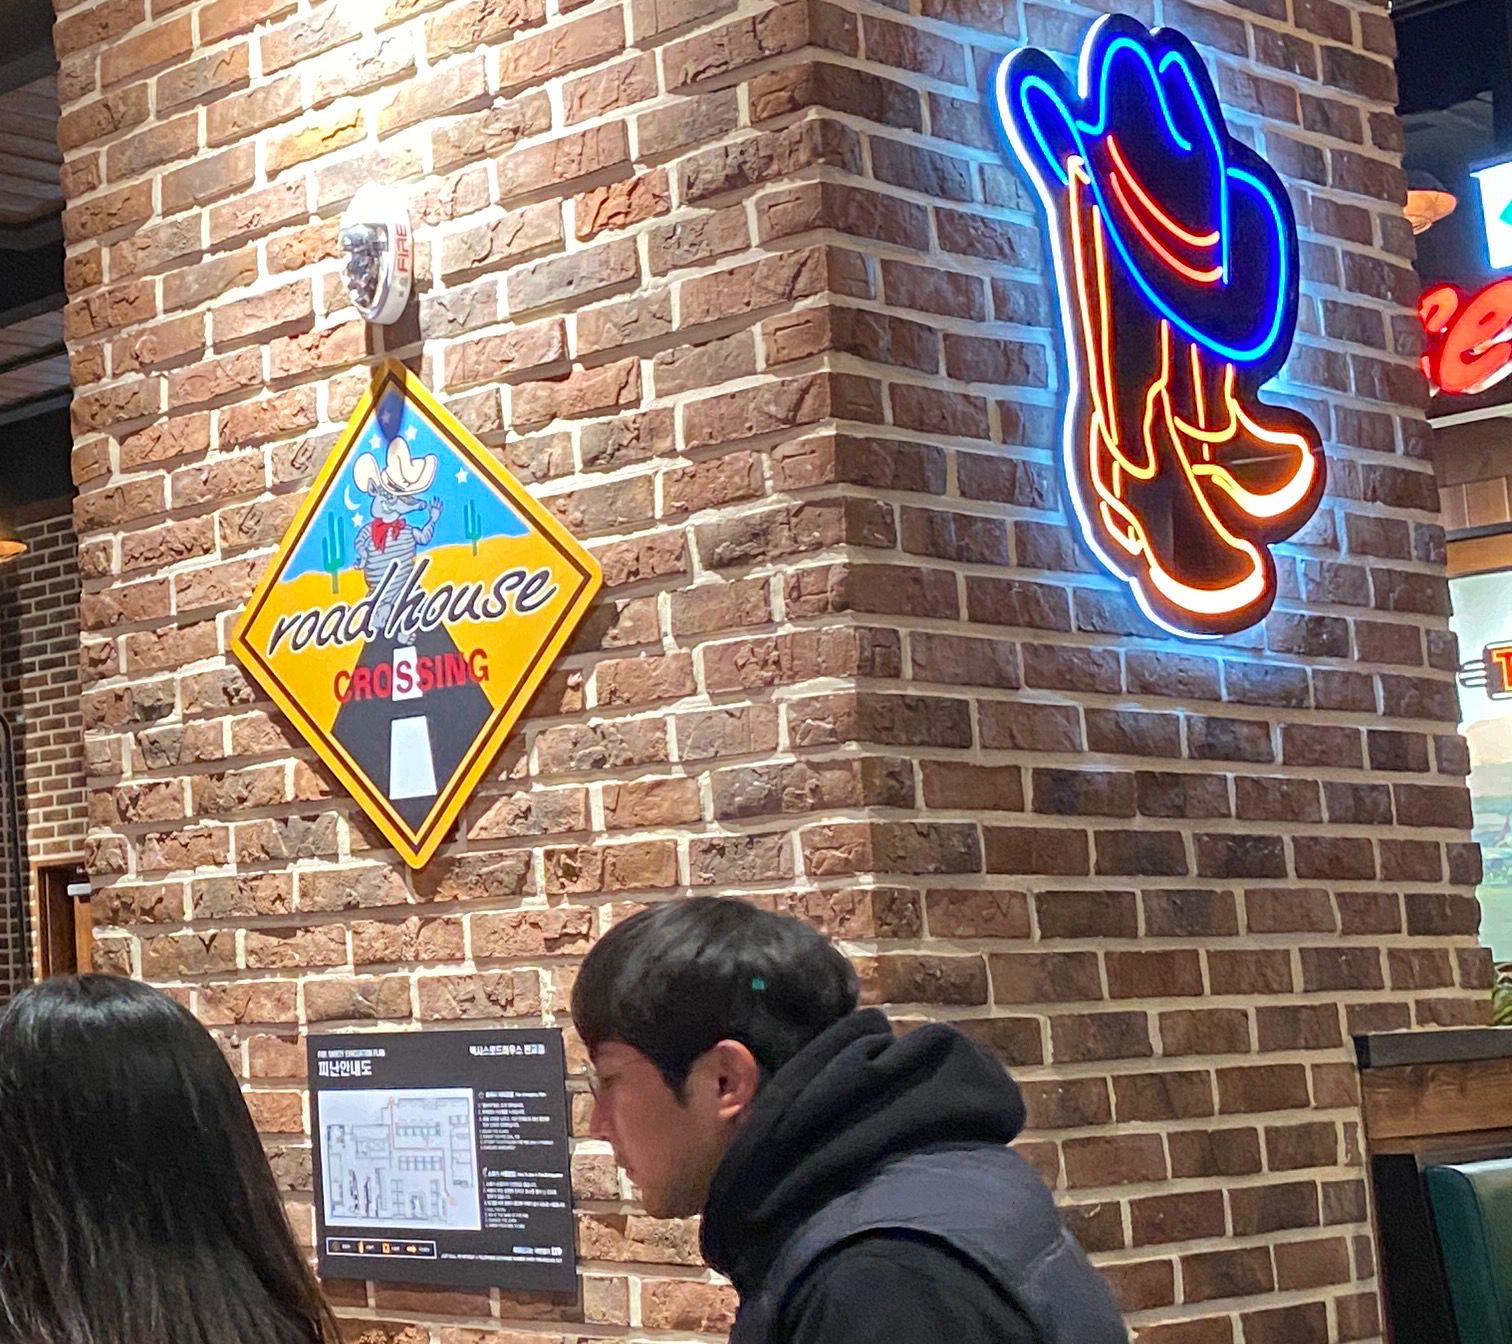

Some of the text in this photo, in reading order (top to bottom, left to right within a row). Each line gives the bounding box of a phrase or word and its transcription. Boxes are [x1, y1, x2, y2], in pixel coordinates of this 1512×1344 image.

[395, 223, 409, 273] FIRE
[267, 557, 558, 656] roadhouse
[334, 647, 489, 704] CROSSING
[317, 1059, 373, 1077] 피난안내도
